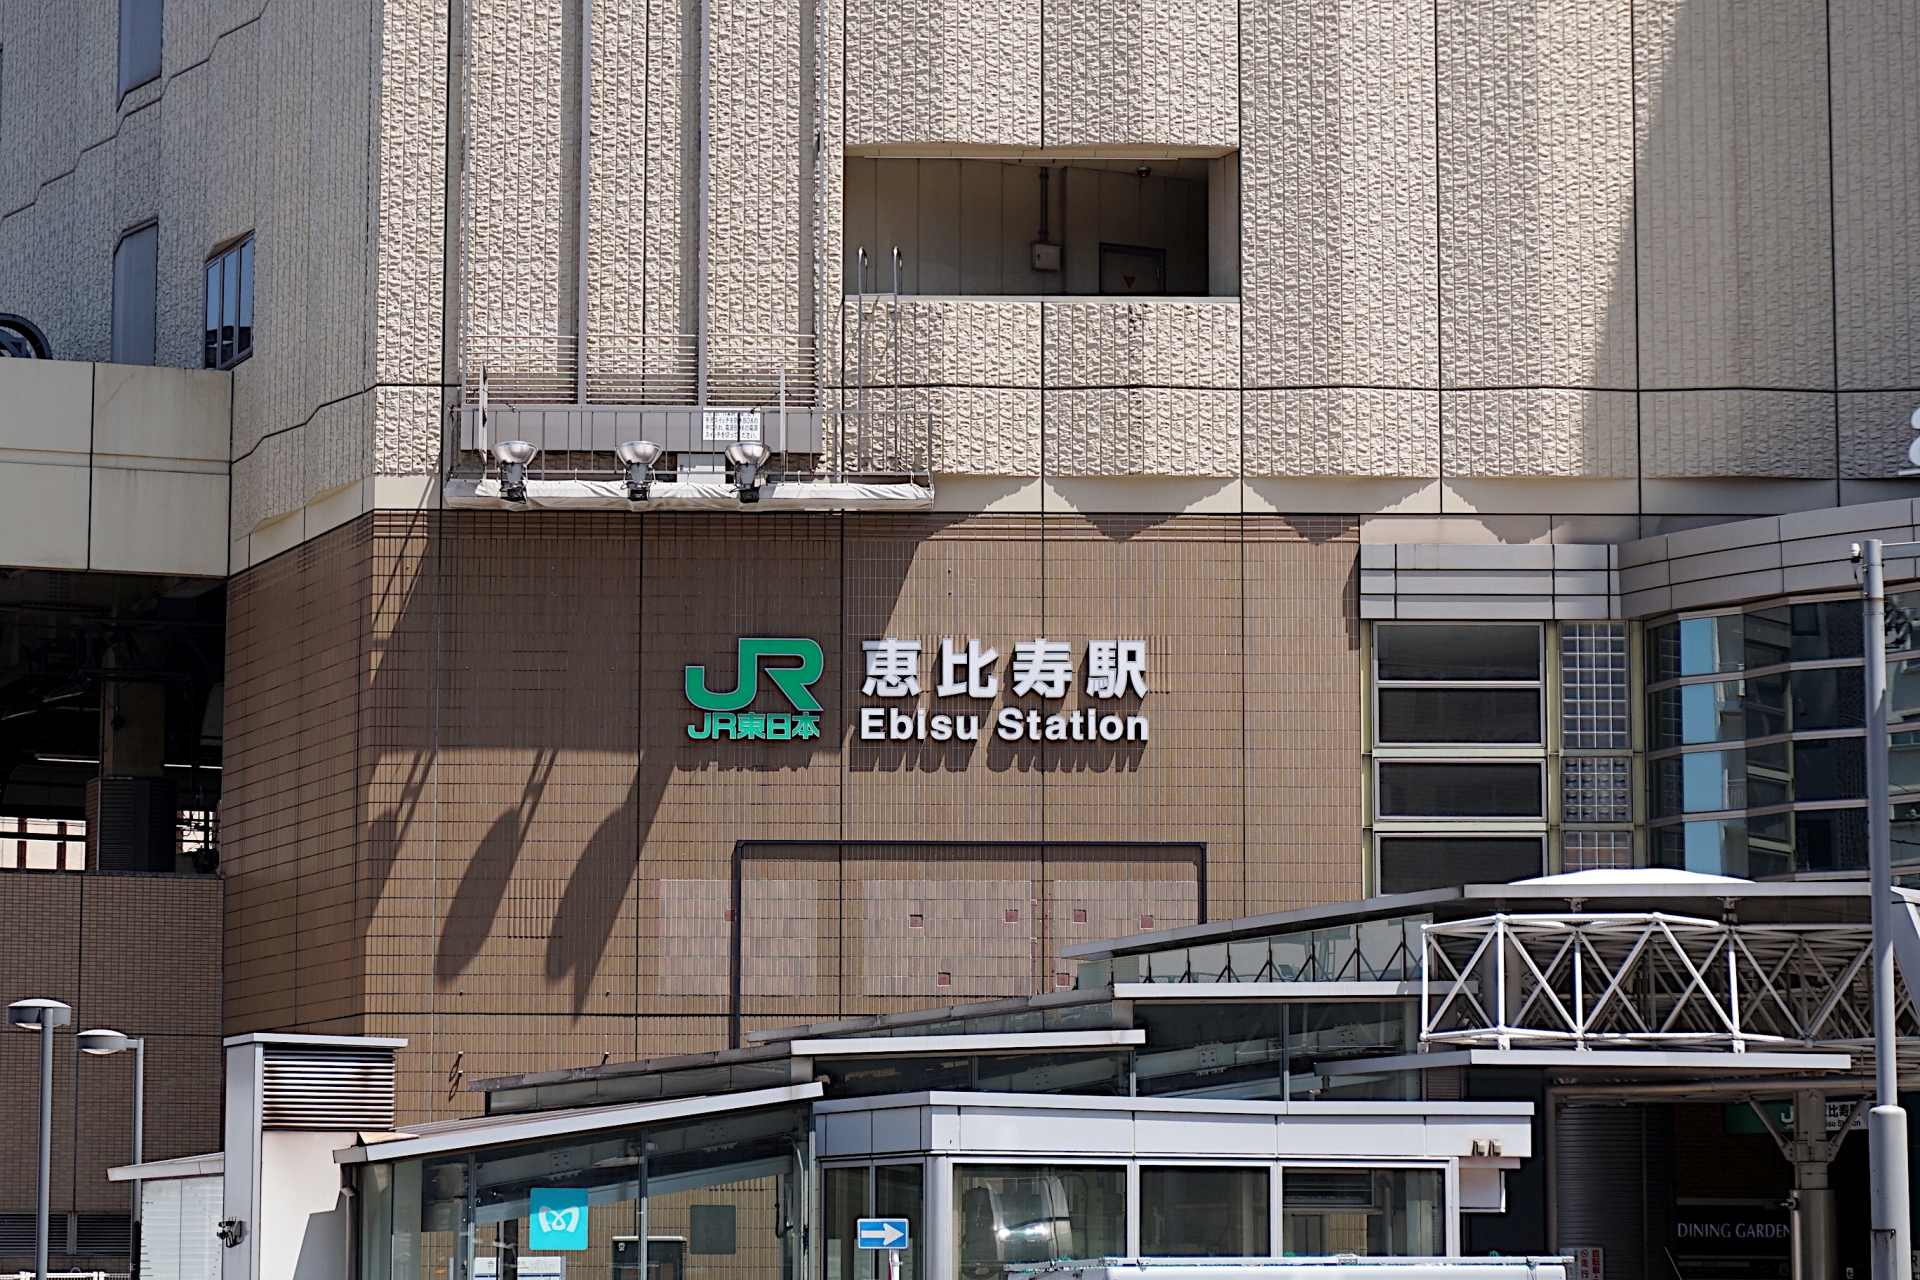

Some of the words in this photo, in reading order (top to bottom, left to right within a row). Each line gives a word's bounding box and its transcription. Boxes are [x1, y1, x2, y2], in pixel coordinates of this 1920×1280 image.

[685, 638, 824, 711] JR
[861, 637, 1148, 699] 恵比寿駅
[688, 712, 820, 740] JR東日本
[861, 708, 979, 741] Ebisu
[997, 707, 1149, 741] Station
[1677, 1222, 1731, 1238] DINING
